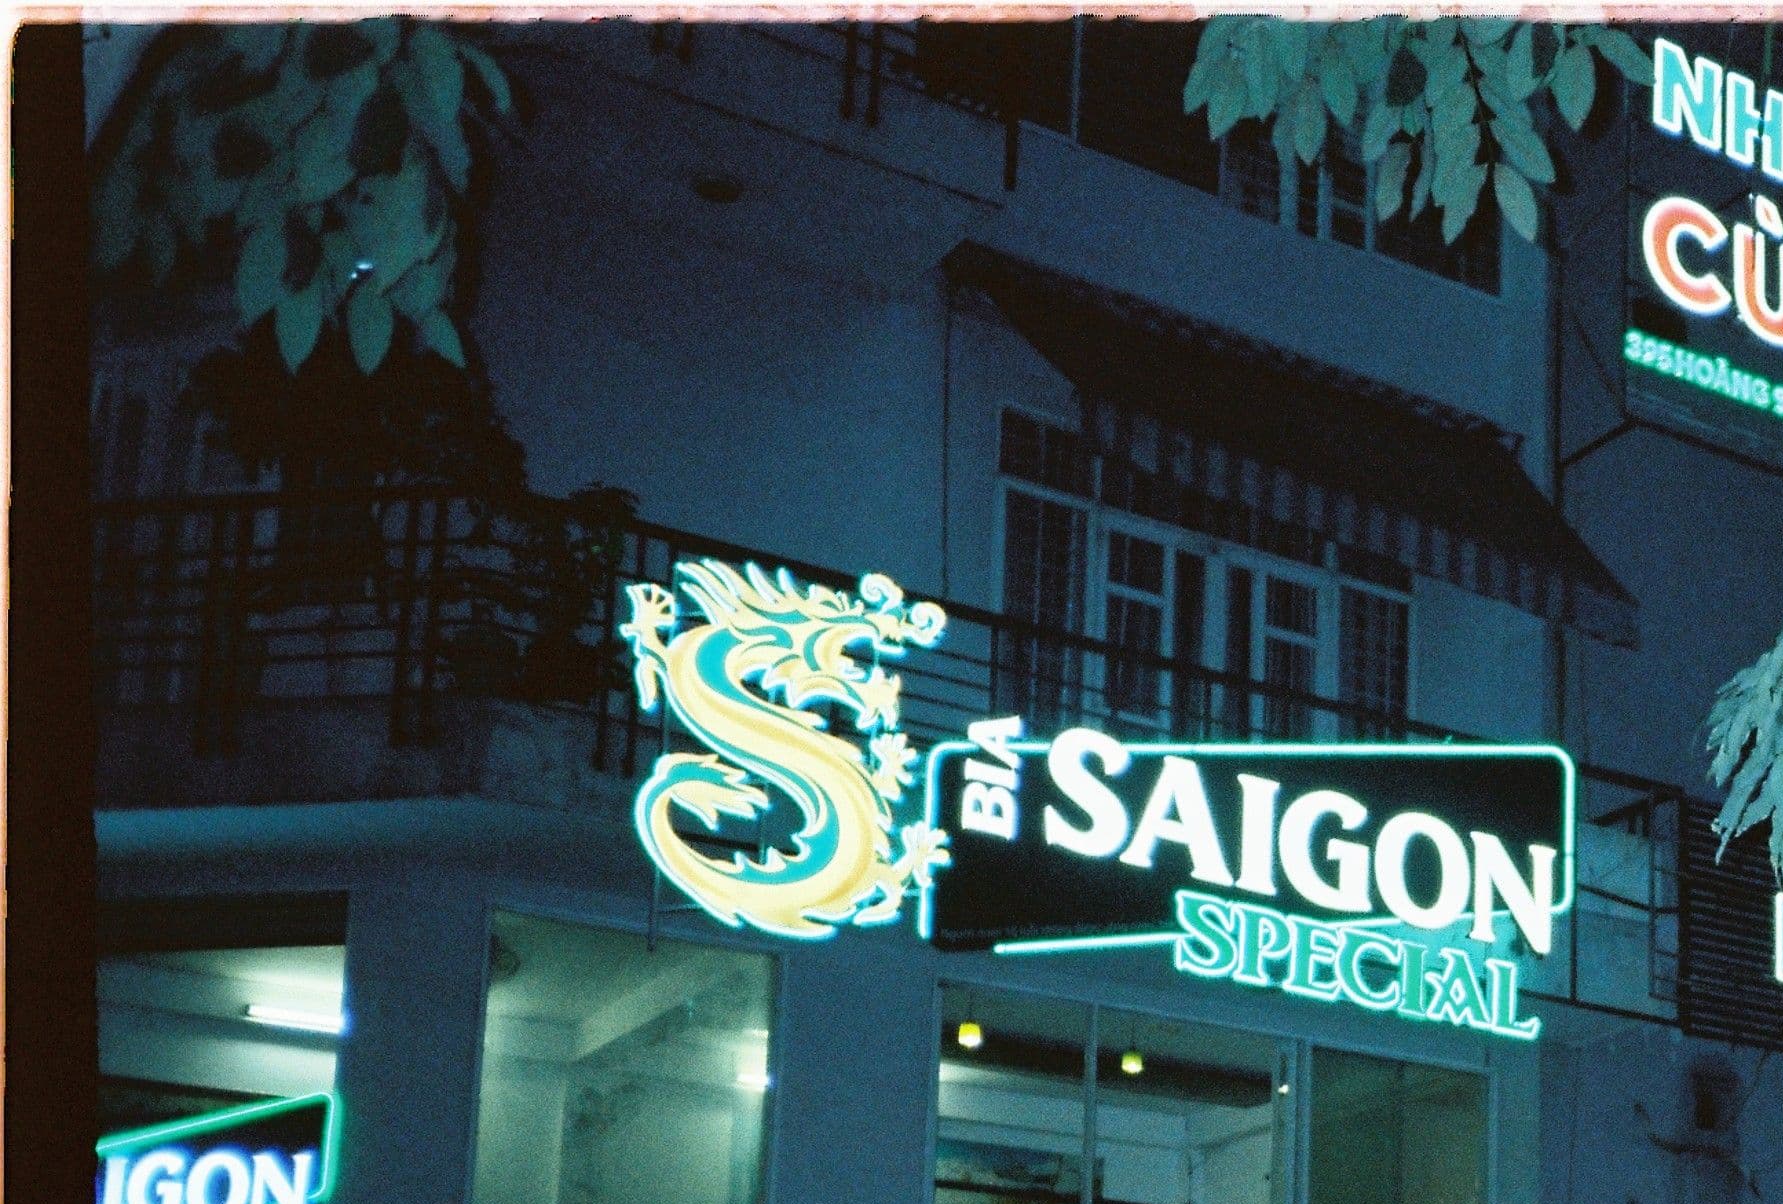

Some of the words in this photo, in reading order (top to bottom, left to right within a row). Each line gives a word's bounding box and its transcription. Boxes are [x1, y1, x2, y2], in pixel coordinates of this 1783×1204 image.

[961, 715, 1023, 840] BIA
[1045, 728, 1557, 954] SAIGON
[1176, 890, 1541, 1039] SPECIAL
